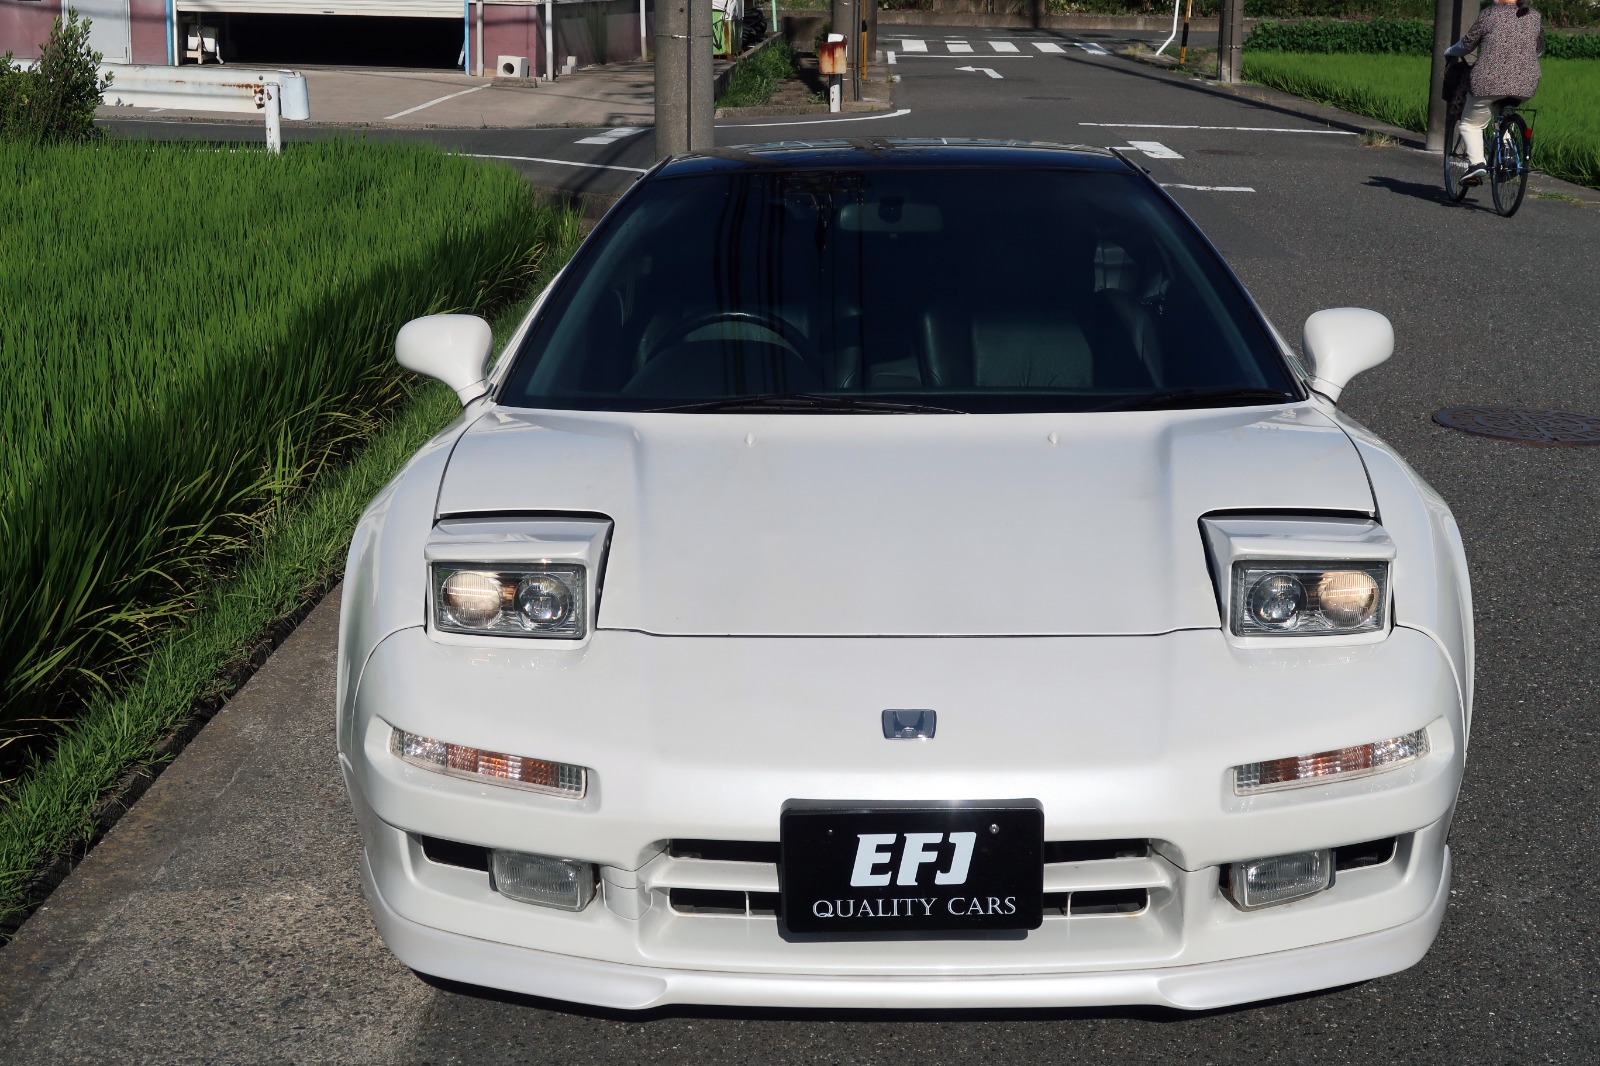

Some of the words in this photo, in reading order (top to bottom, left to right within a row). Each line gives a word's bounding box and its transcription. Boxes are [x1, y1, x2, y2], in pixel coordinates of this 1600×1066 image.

[850, 832, 977, 887] EFJ
[812, 897, 938, 918] QUALITY
[947, 896, 1017, 916] CARS
